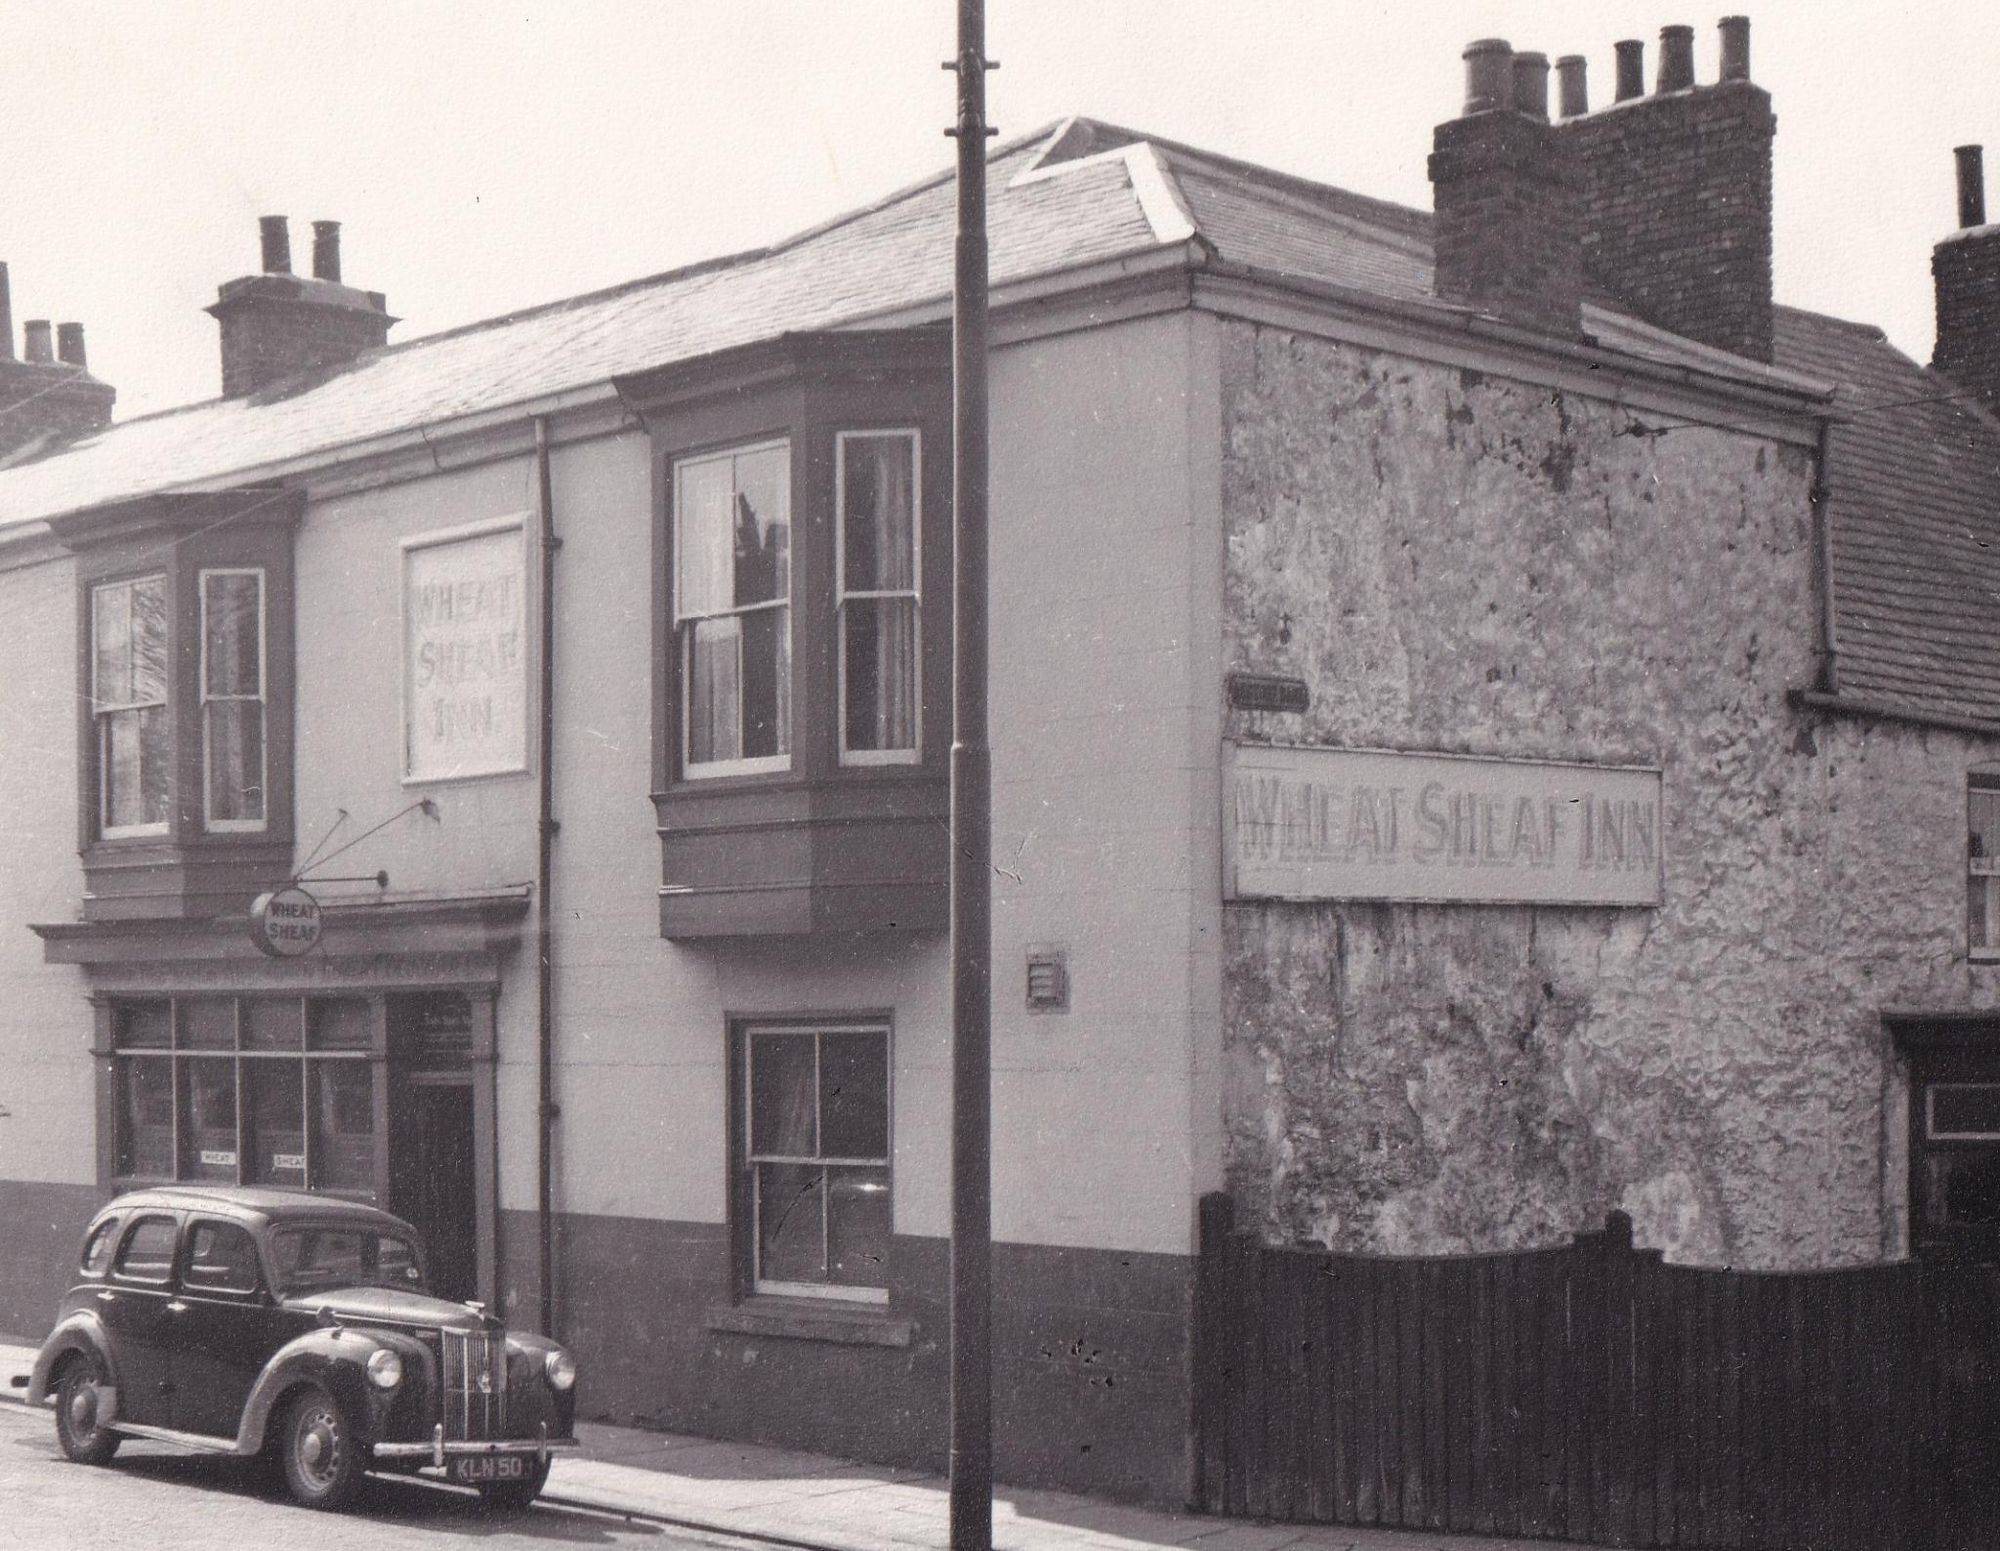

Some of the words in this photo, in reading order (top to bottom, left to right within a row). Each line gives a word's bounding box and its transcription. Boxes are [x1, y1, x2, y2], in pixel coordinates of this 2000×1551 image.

[434, 697, 495, 740] INN
[1236, 775, 1404, 864] WHEAT
[1413, 780, 1566, 868] SHEAF
[1579, 791, 1655, 872] INN
[270, 902, 316, 918] WHEAT
[269, 922, 317, 941] SHEAF
